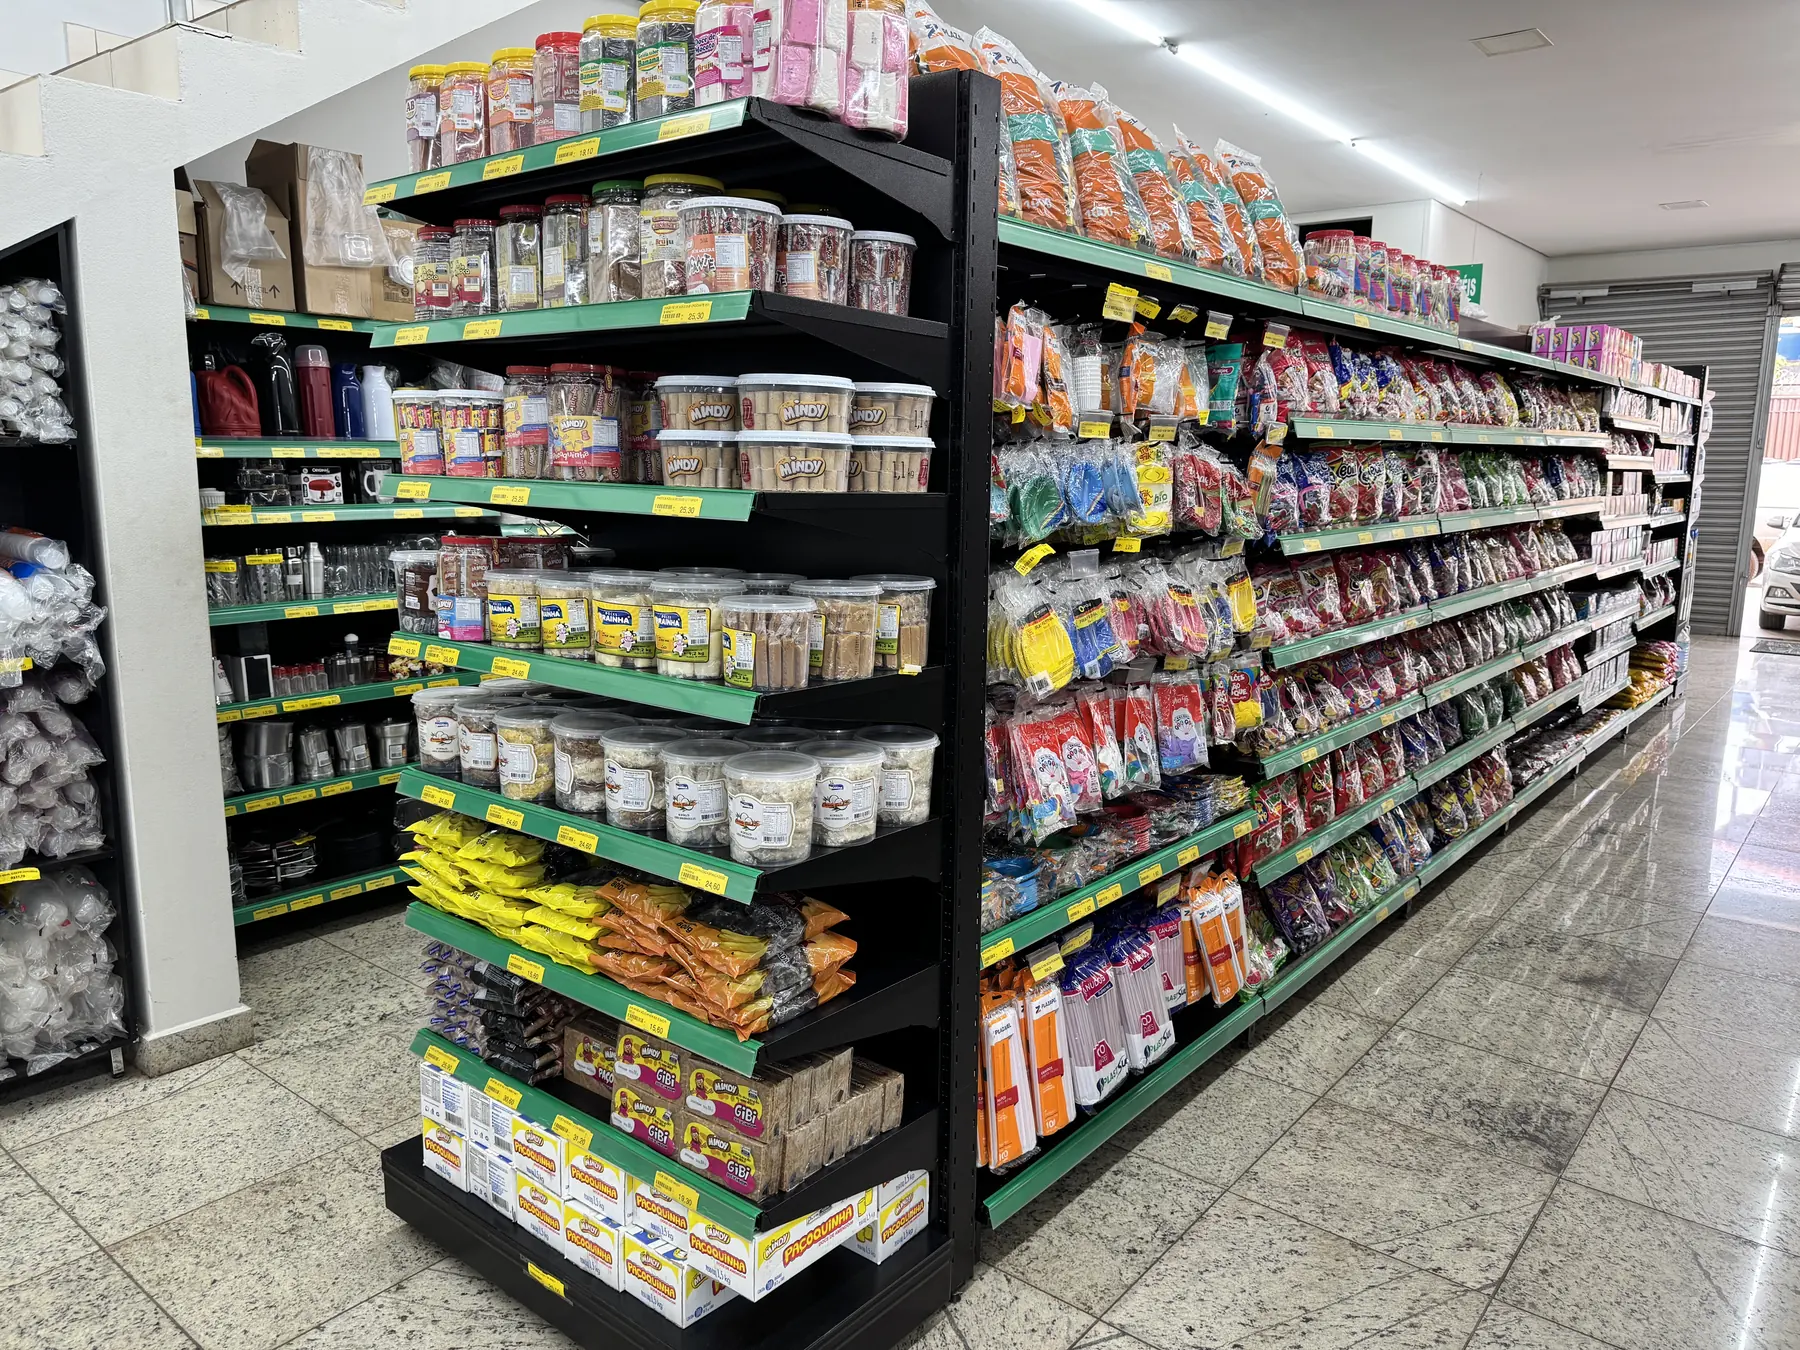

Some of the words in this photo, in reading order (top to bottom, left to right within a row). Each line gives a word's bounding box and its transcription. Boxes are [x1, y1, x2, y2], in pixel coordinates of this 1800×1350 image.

[638, 56, 660, 68] Banana
[580, 70, 600, 80] Banana
[1464, 274, 1476, 296] ÉIS
[688, 311, 705, 322] 25,30
[689, 400, 732, 421] MINDY
[782, 400, 826, 421] MINDY
[562, 420, 586, 431] MINDY
[666, 456, 700, 474] MINDY
[780, 457, 824, 476] MINDY
[679, 506, 695, 515] 25,30
[600, 614, 630, 624] RAINHA
[512, 669, 524, 678] 24,60
[578, 842, 592, 850] 24,60
[704, 880, 721, 891] 24,60
[649, 1024, 664, 1035] 15,60
[641, 1046, 660, 1060] MINDY
[598, 1068, 614, 1085] PAÇO
[714, 1080, 738, 1093] MINDY
[634, 1100, 655, 1114] MINDY
[425, 1138, 460, 1167] PAÇOQUINHA
[708, 1137, 729, 1151] MINDY
[514, 1140, 556, 1173] PAÇOQUINHA
[570, 1164, 618, 1200] PAÇOQUINHA
[678, 1194, 692, 1207] 19,30
[519, 1196, 561, 1232] PAÇOQUINHA
[634, 1193, 688, 1231] PAÇOQUINHA
[882, 1200, 925, 1244] PAÇOQUINHA
[706, 1224, 730, 1244] MINDY
[783, 1204, 854, 1268] PAÇOQUINHA
[566, 1228, 613, 1266] PAÇOQUINHA
[690, 1232, 747, 1274] PAÇOQUINHA
[764, 1232, 790, 1260] MINDY
[640, 1252, 662, 1272] MINDY
[626, 1258, 676, 1300] PAÇOQUINHA
